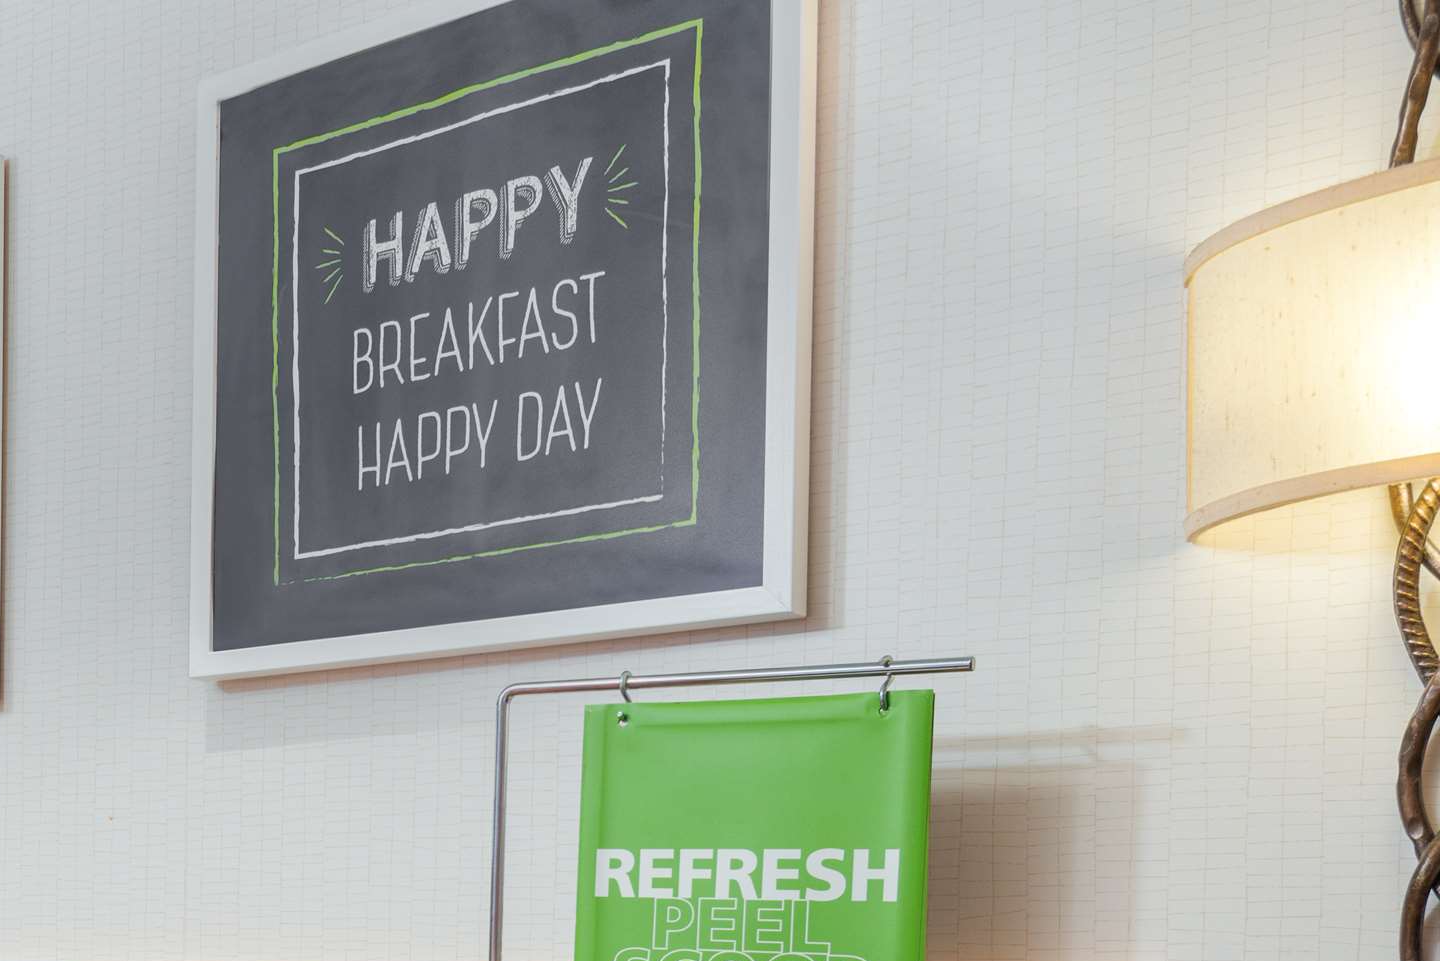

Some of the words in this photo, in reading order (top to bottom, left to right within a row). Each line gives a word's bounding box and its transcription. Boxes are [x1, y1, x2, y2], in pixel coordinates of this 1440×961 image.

[362, 156, 594, 294] HAPPY
[352, 270, 607, 395] BREAKFAST
[358, 399, 499, 491] HAPPY
[516, 377, 603, 462] DAY
[594, 847, 901, 903] REFRESH
[652, 896, 831, 955] PEEL
